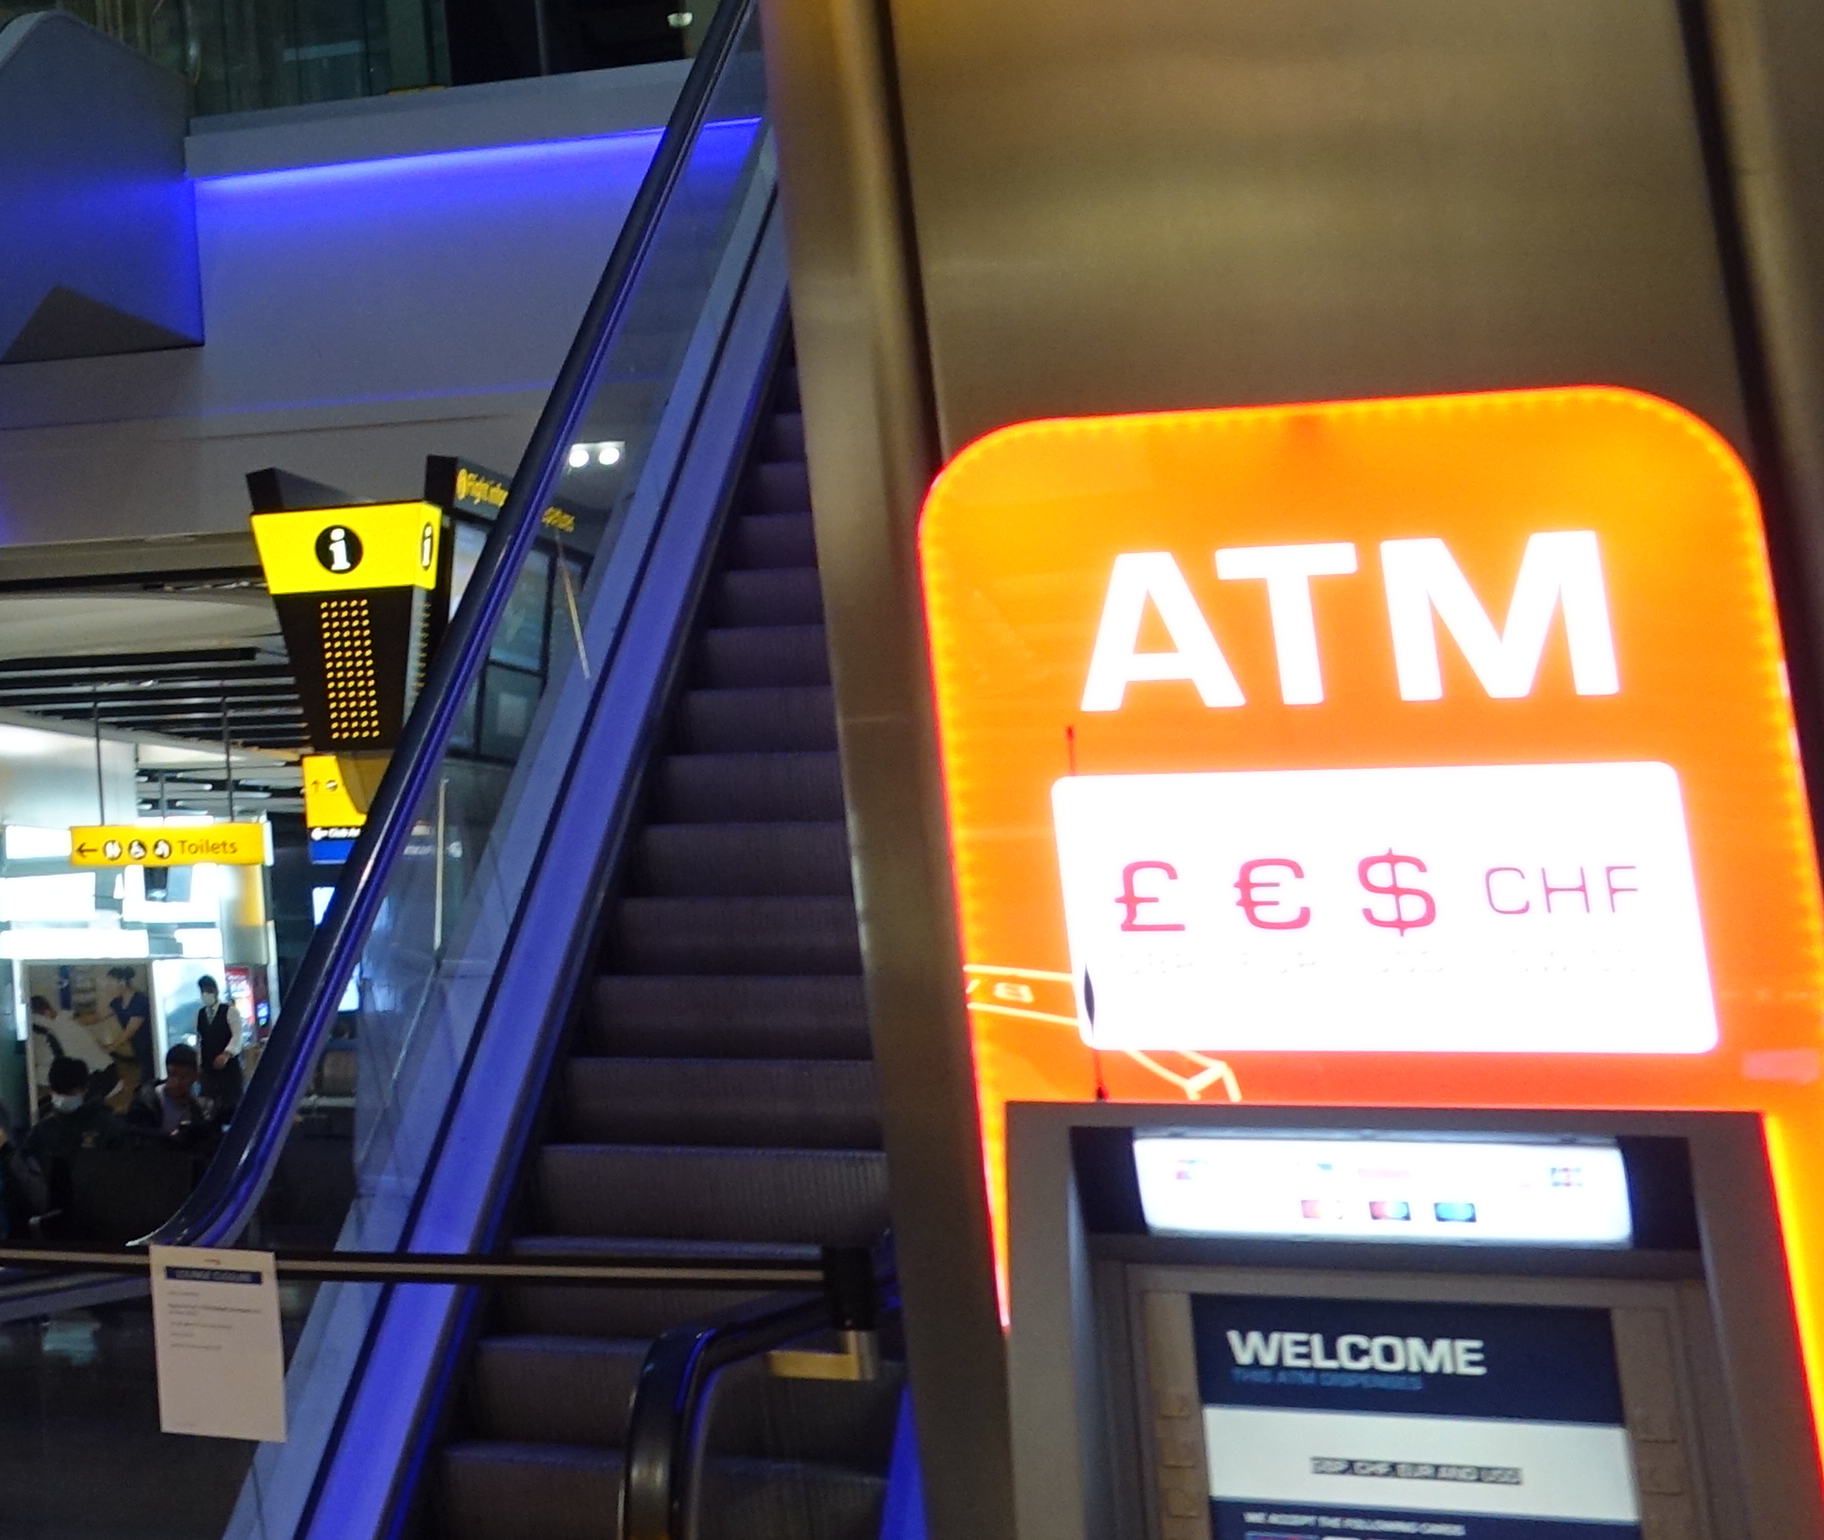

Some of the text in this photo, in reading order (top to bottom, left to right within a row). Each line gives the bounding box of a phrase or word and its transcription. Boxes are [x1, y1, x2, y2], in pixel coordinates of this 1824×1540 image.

[1079, 528, 1622, 713] ATM
[177, 838, 238, 856] Toilets
[1114, 846, 1640, 938] £ € $ CHF
[1225, 1329, 1488, 1377] WELCOME
